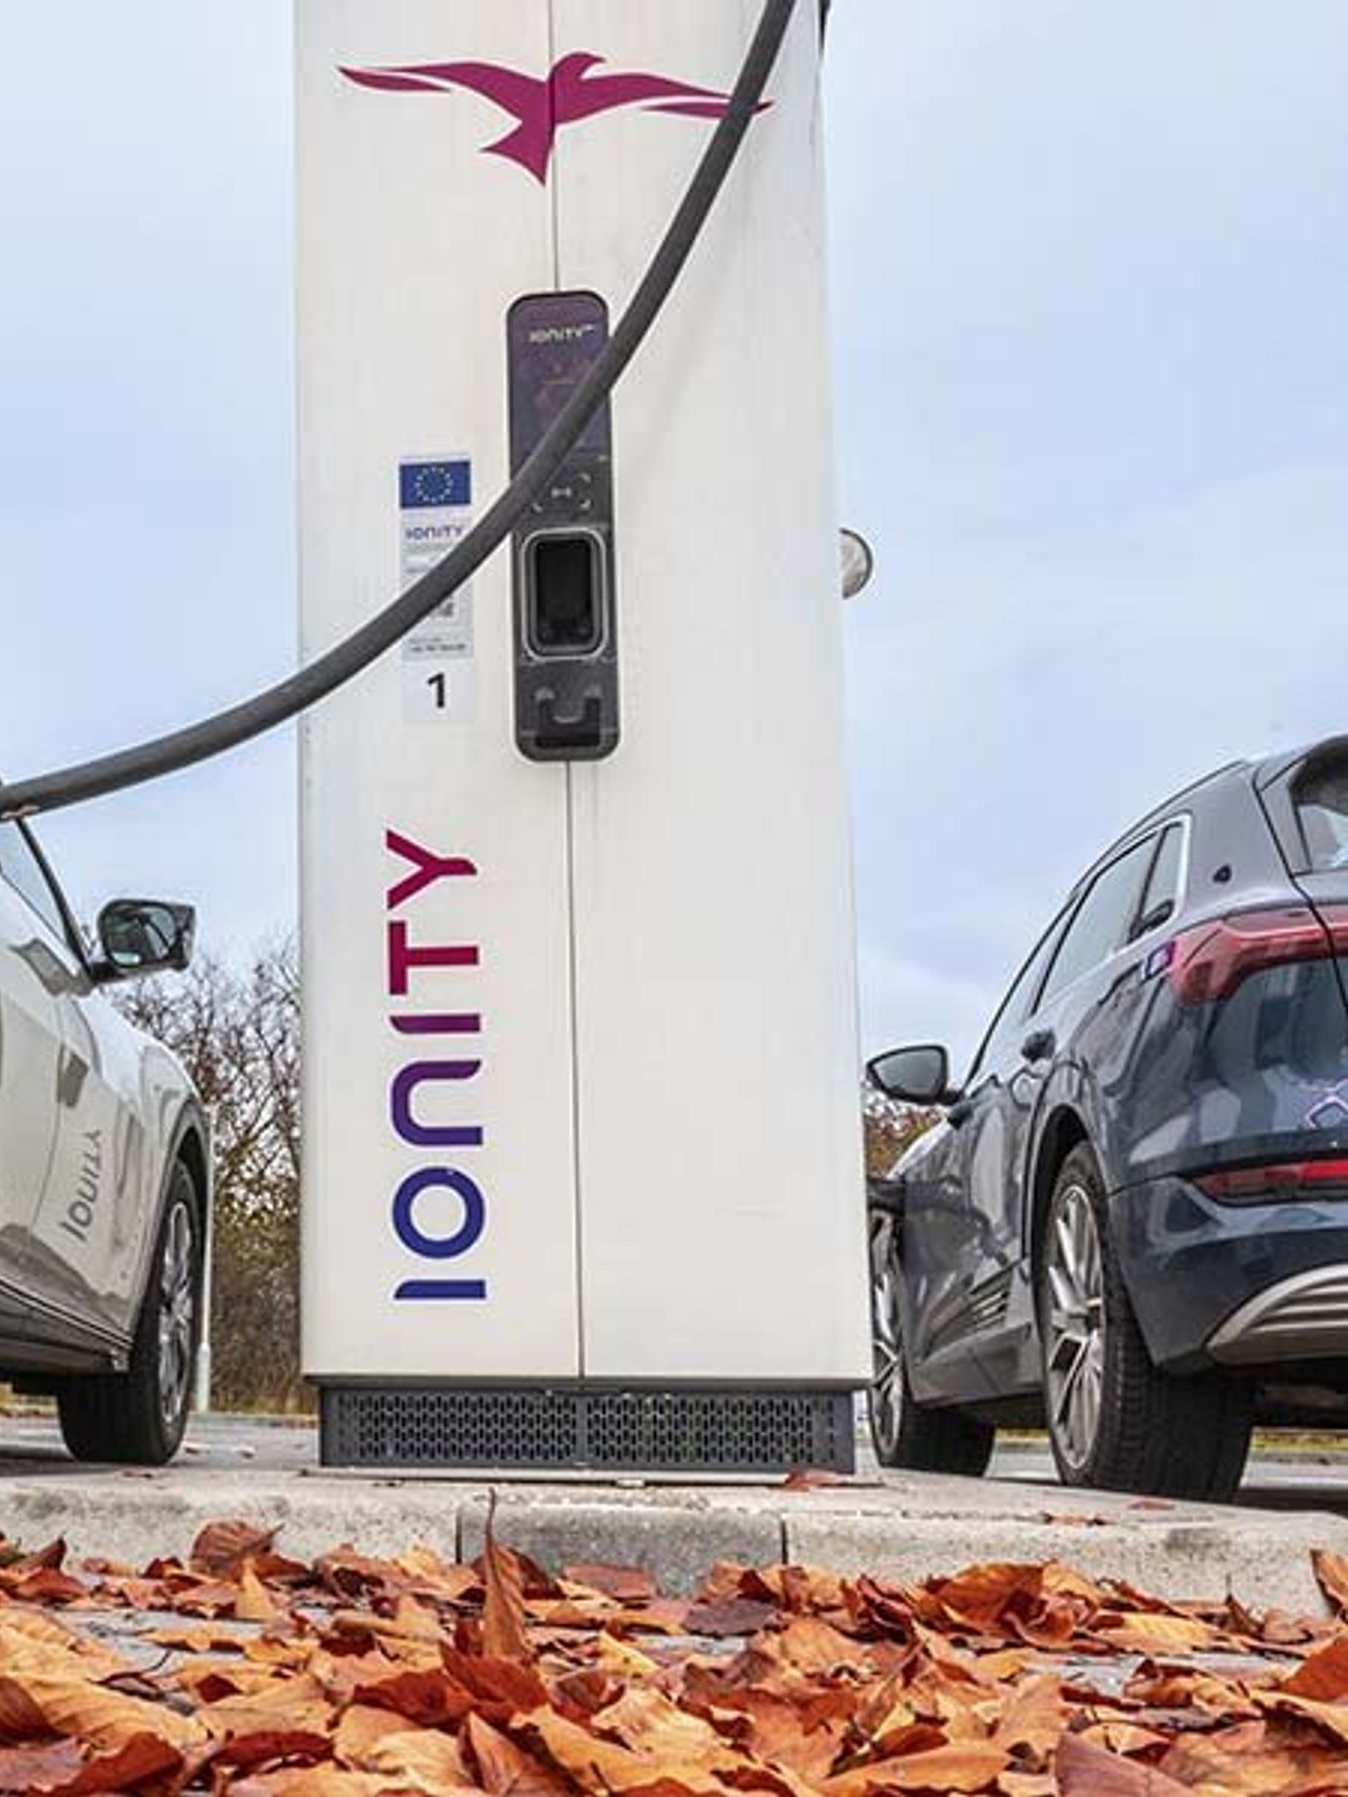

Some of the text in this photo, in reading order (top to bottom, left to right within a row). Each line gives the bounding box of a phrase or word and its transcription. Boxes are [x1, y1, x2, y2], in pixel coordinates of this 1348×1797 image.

[406, 526, 464, 540] IONITY
[427, 672, 445, 708] 1
[386, 829, 487, 1300] IONITY
